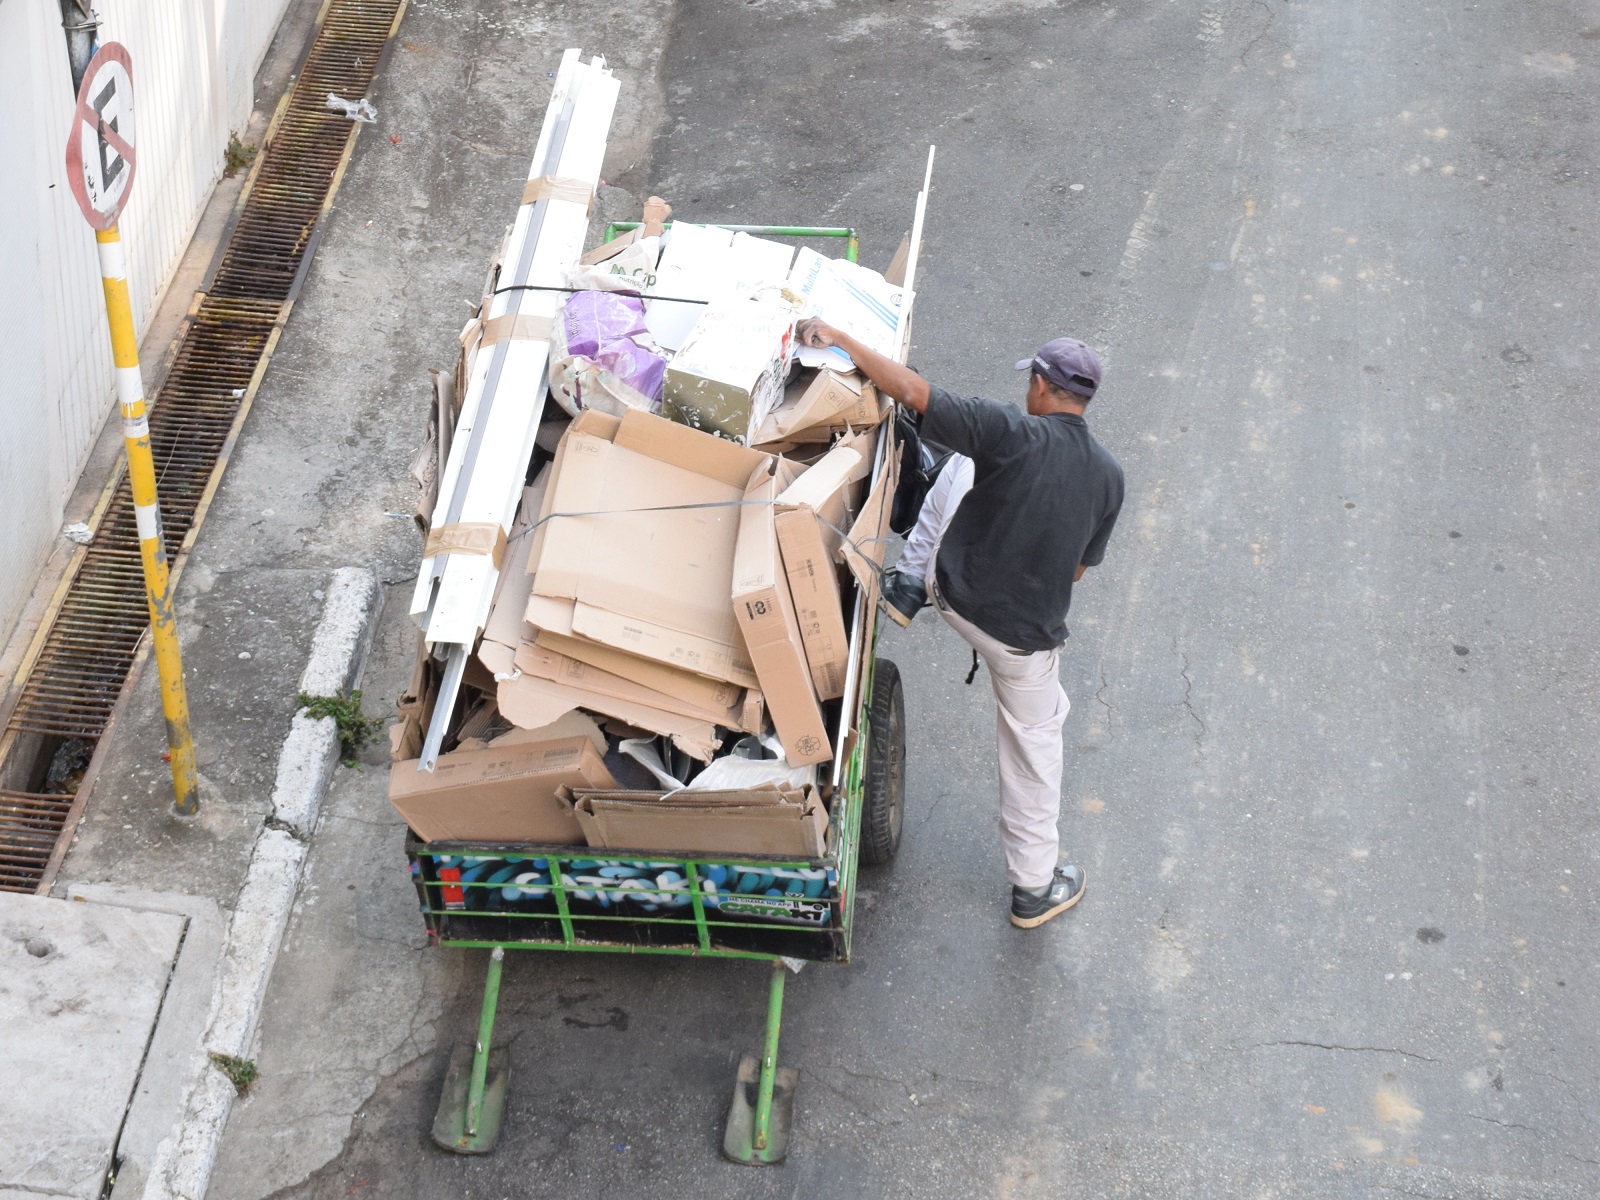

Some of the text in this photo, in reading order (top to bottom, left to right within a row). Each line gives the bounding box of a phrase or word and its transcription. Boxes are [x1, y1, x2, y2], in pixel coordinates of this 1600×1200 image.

[93, 76, 125, 193] E
[801, 256, 824, 295] MultiLan
[719, 902, 826, 921] CATAKI
